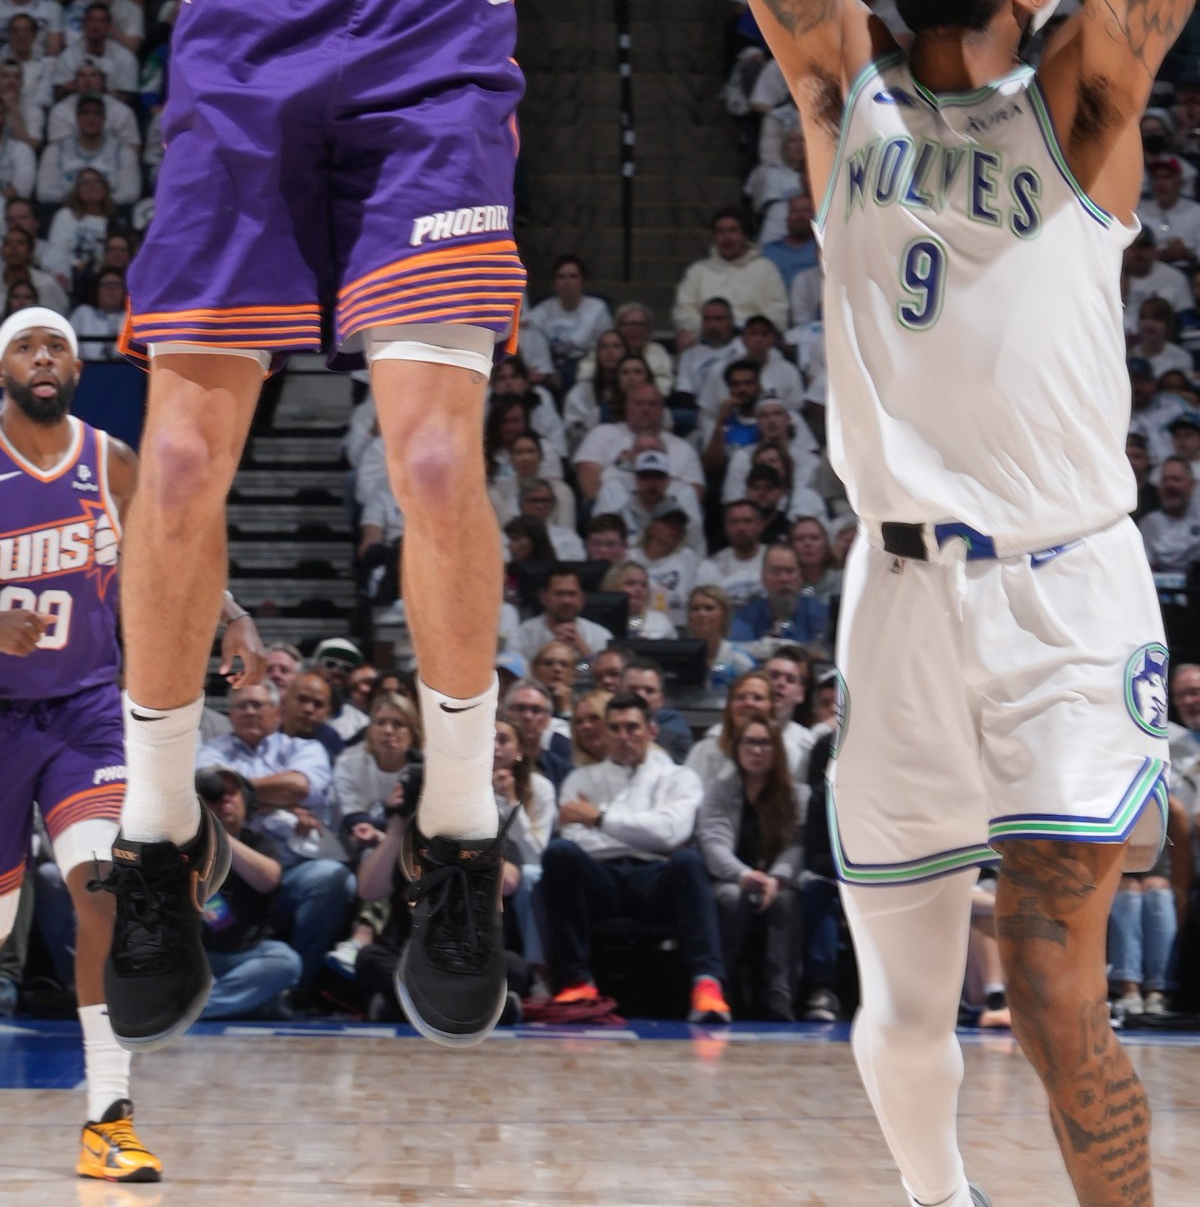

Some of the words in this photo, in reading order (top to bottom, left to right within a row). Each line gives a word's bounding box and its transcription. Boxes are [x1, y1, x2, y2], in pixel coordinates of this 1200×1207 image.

[408, 204, 510, 247] PHOENIX
[845, 135, 1043, 241] WOLVES
[896, 235, 949, 332] 9
